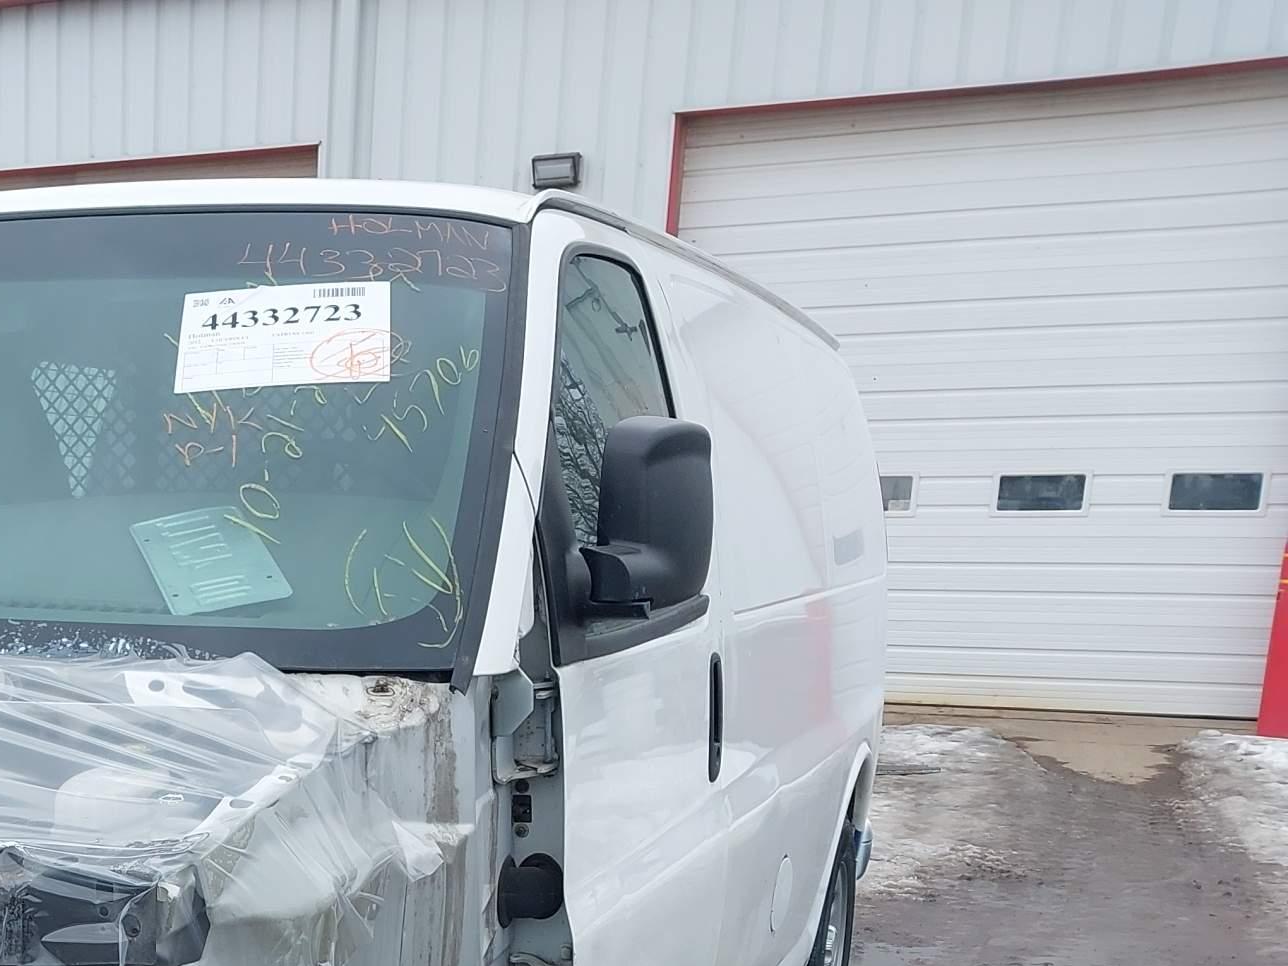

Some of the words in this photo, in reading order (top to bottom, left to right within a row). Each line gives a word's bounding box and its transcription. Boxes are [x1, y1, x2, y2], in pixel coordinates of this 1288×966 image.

[328, 214, 490, 250] HOLMAN
[238, 241, 507, 292] 44332723
[201, 302, 363, 331] 44332723
